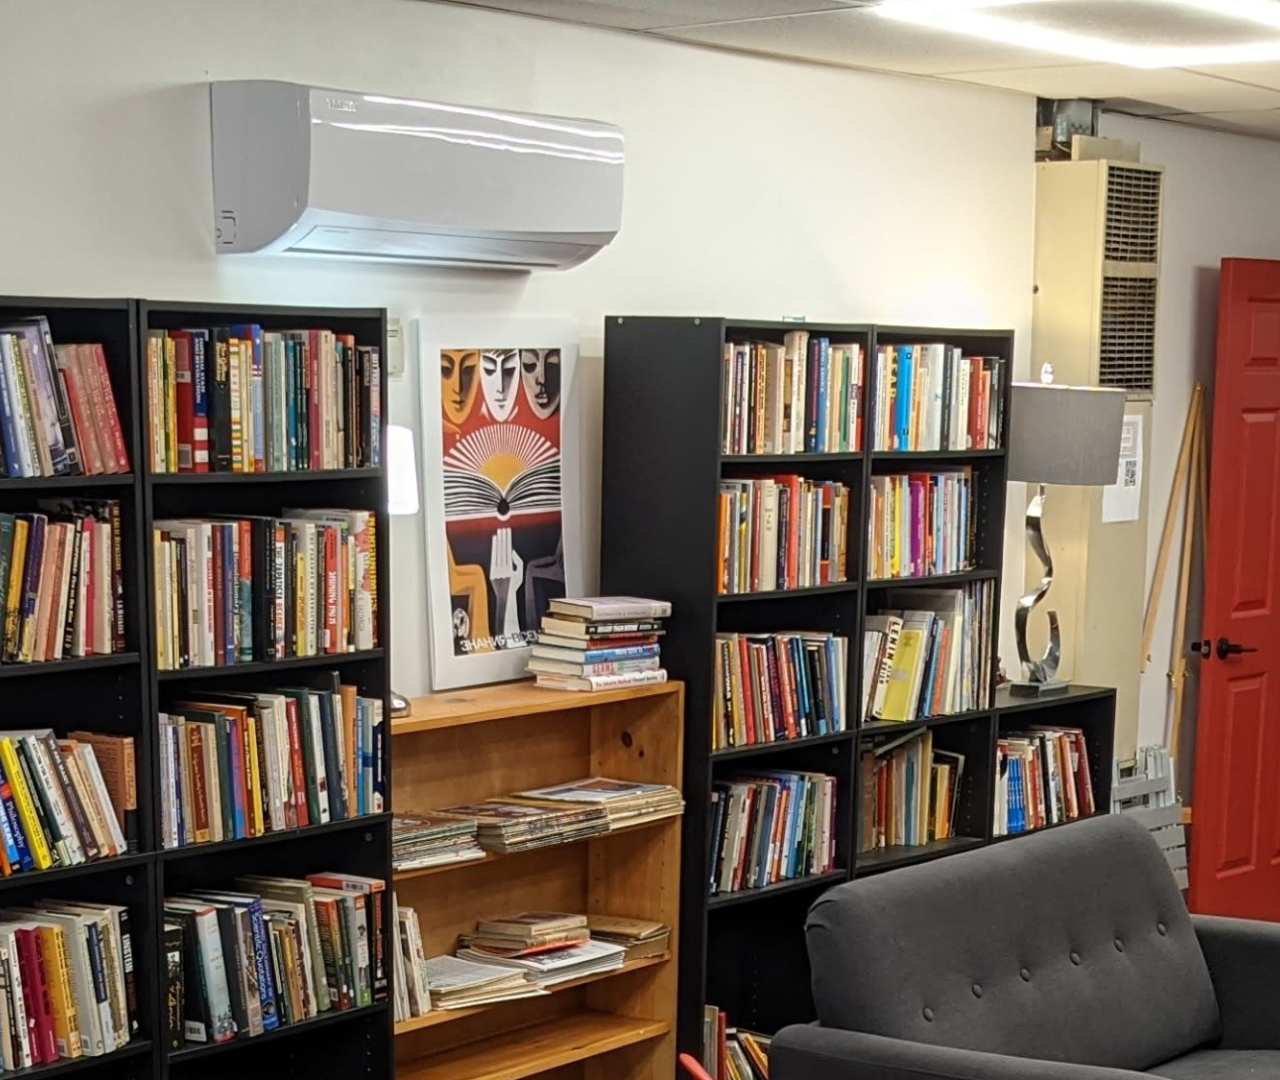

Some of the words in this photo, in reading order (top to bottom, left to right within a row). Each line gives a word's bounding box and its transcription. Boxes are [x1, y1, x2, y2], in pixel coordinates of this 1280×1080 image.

[886, 620, 902, 661] LENIN
[6, 801, 27, 849] Philosophy
[122, 934, 133, 973] EINSTEIN
